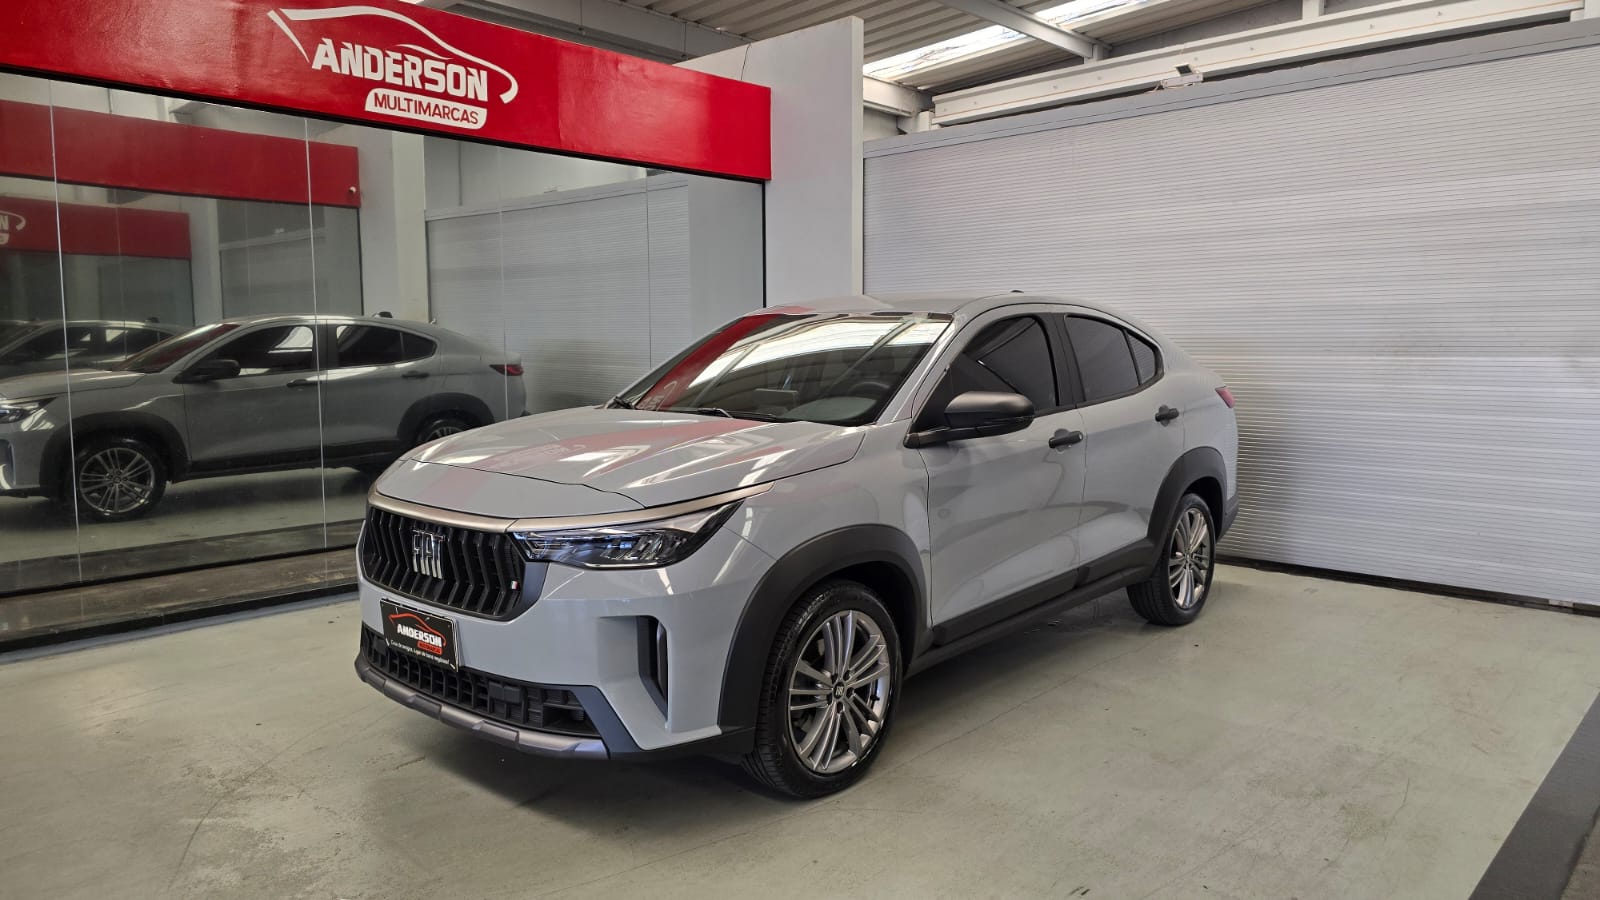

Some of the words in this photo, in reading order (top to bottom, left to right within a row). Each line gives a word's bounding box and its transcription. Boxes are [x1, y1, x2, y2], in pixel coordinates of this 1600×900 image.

[311, 37, 489, 102] ANDERSON
[373, 91, 479, 125] MULTIMARCAS
[412, 529, 445, 579] FIAT
[397, 623, 442, 648] ANDERSON
